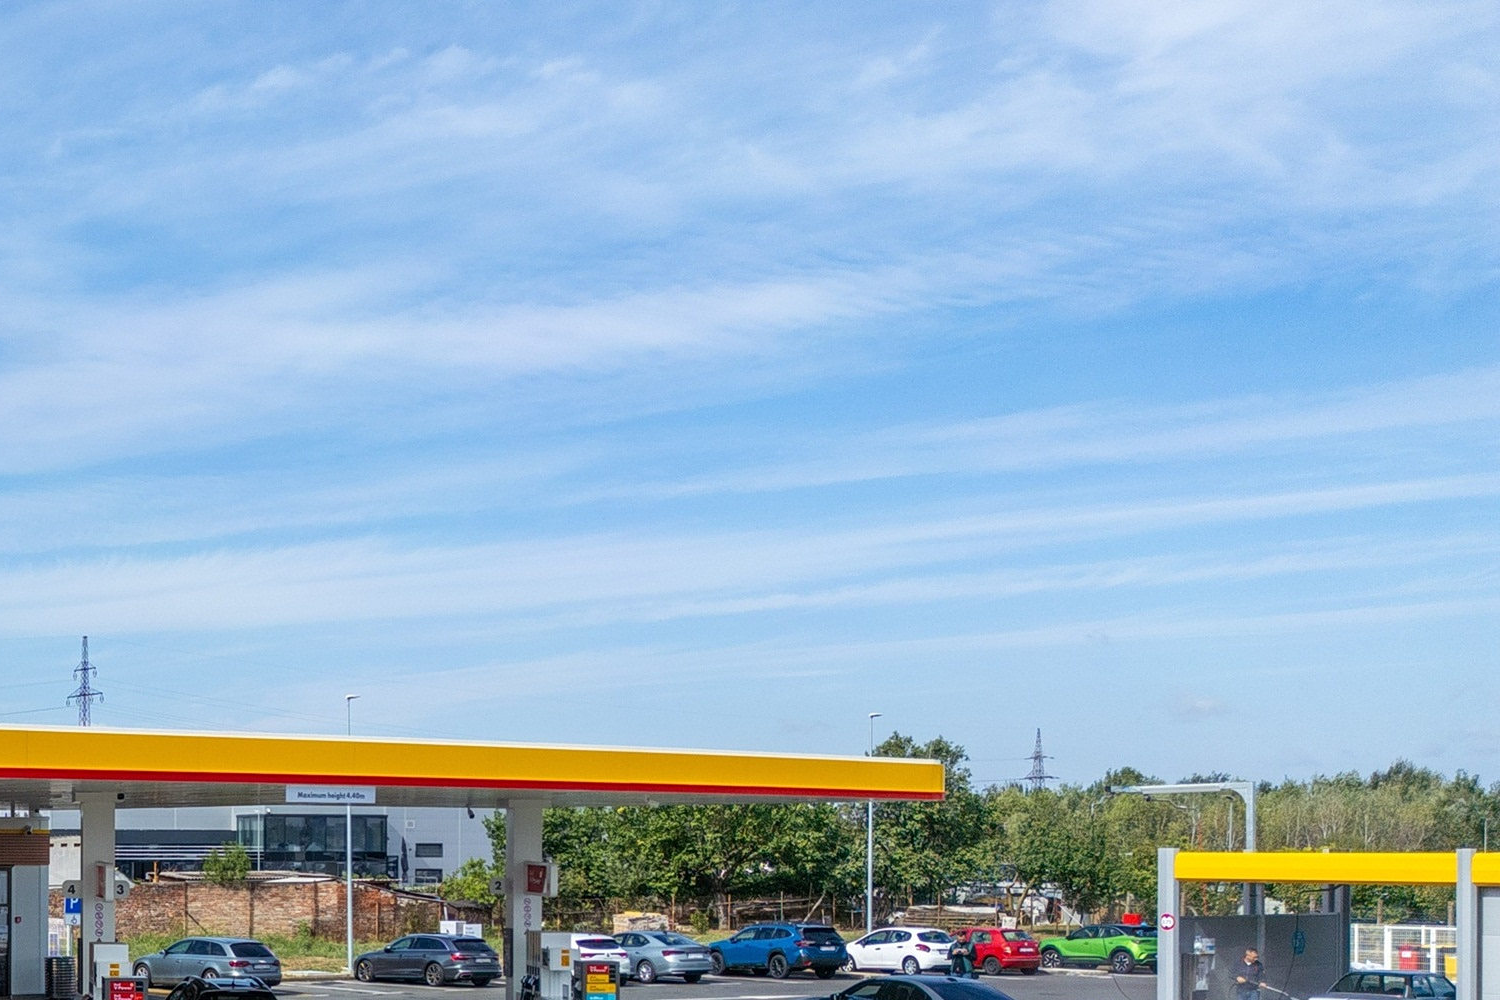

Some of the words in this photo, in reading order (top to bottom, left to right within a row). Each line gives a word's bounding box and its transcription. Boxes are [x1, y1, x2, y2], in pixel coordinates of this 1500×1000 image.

[297, 791, 327, 799] Maximum
[327, 792, 346, 801] height
[67, 884, 76, 895] 4
[116, 884, 124, 895] 3
[494, 880, 502, 890] 2
